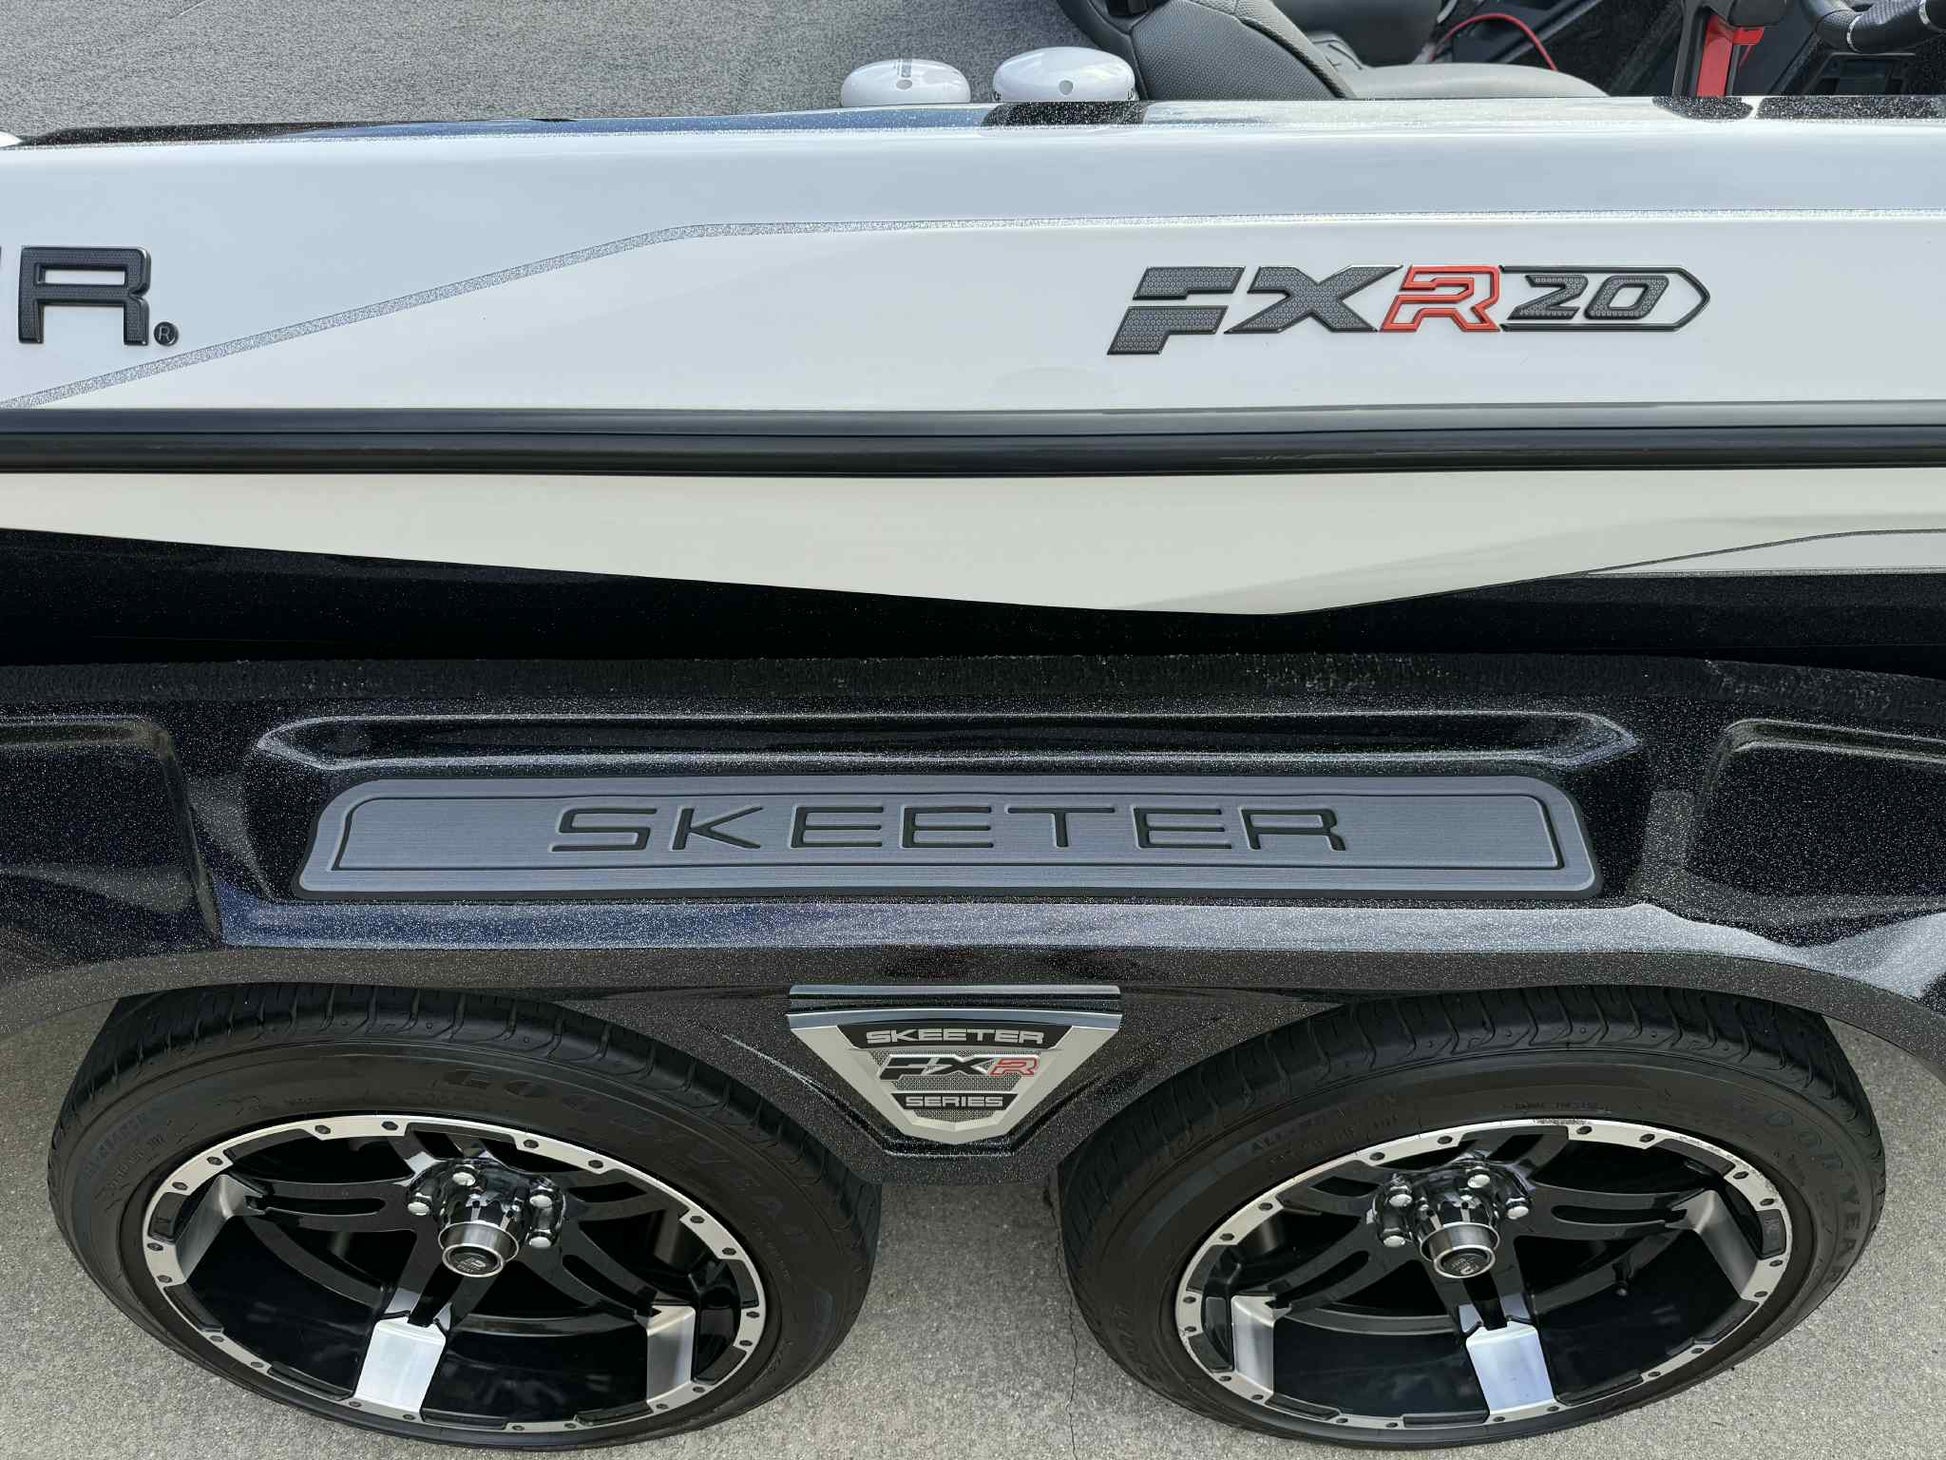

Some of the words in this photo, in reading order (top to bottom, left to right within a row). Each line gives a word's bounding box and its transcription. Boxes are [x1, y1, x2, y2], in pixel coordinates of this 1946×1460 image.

[551, 805, 1346, 853] SKEETER
[866, 1027, 1045, 1045] SKEETER
[876, 1053, 1040, 1081] FXR
[905, 1096, 1003, 1107] SERIES
